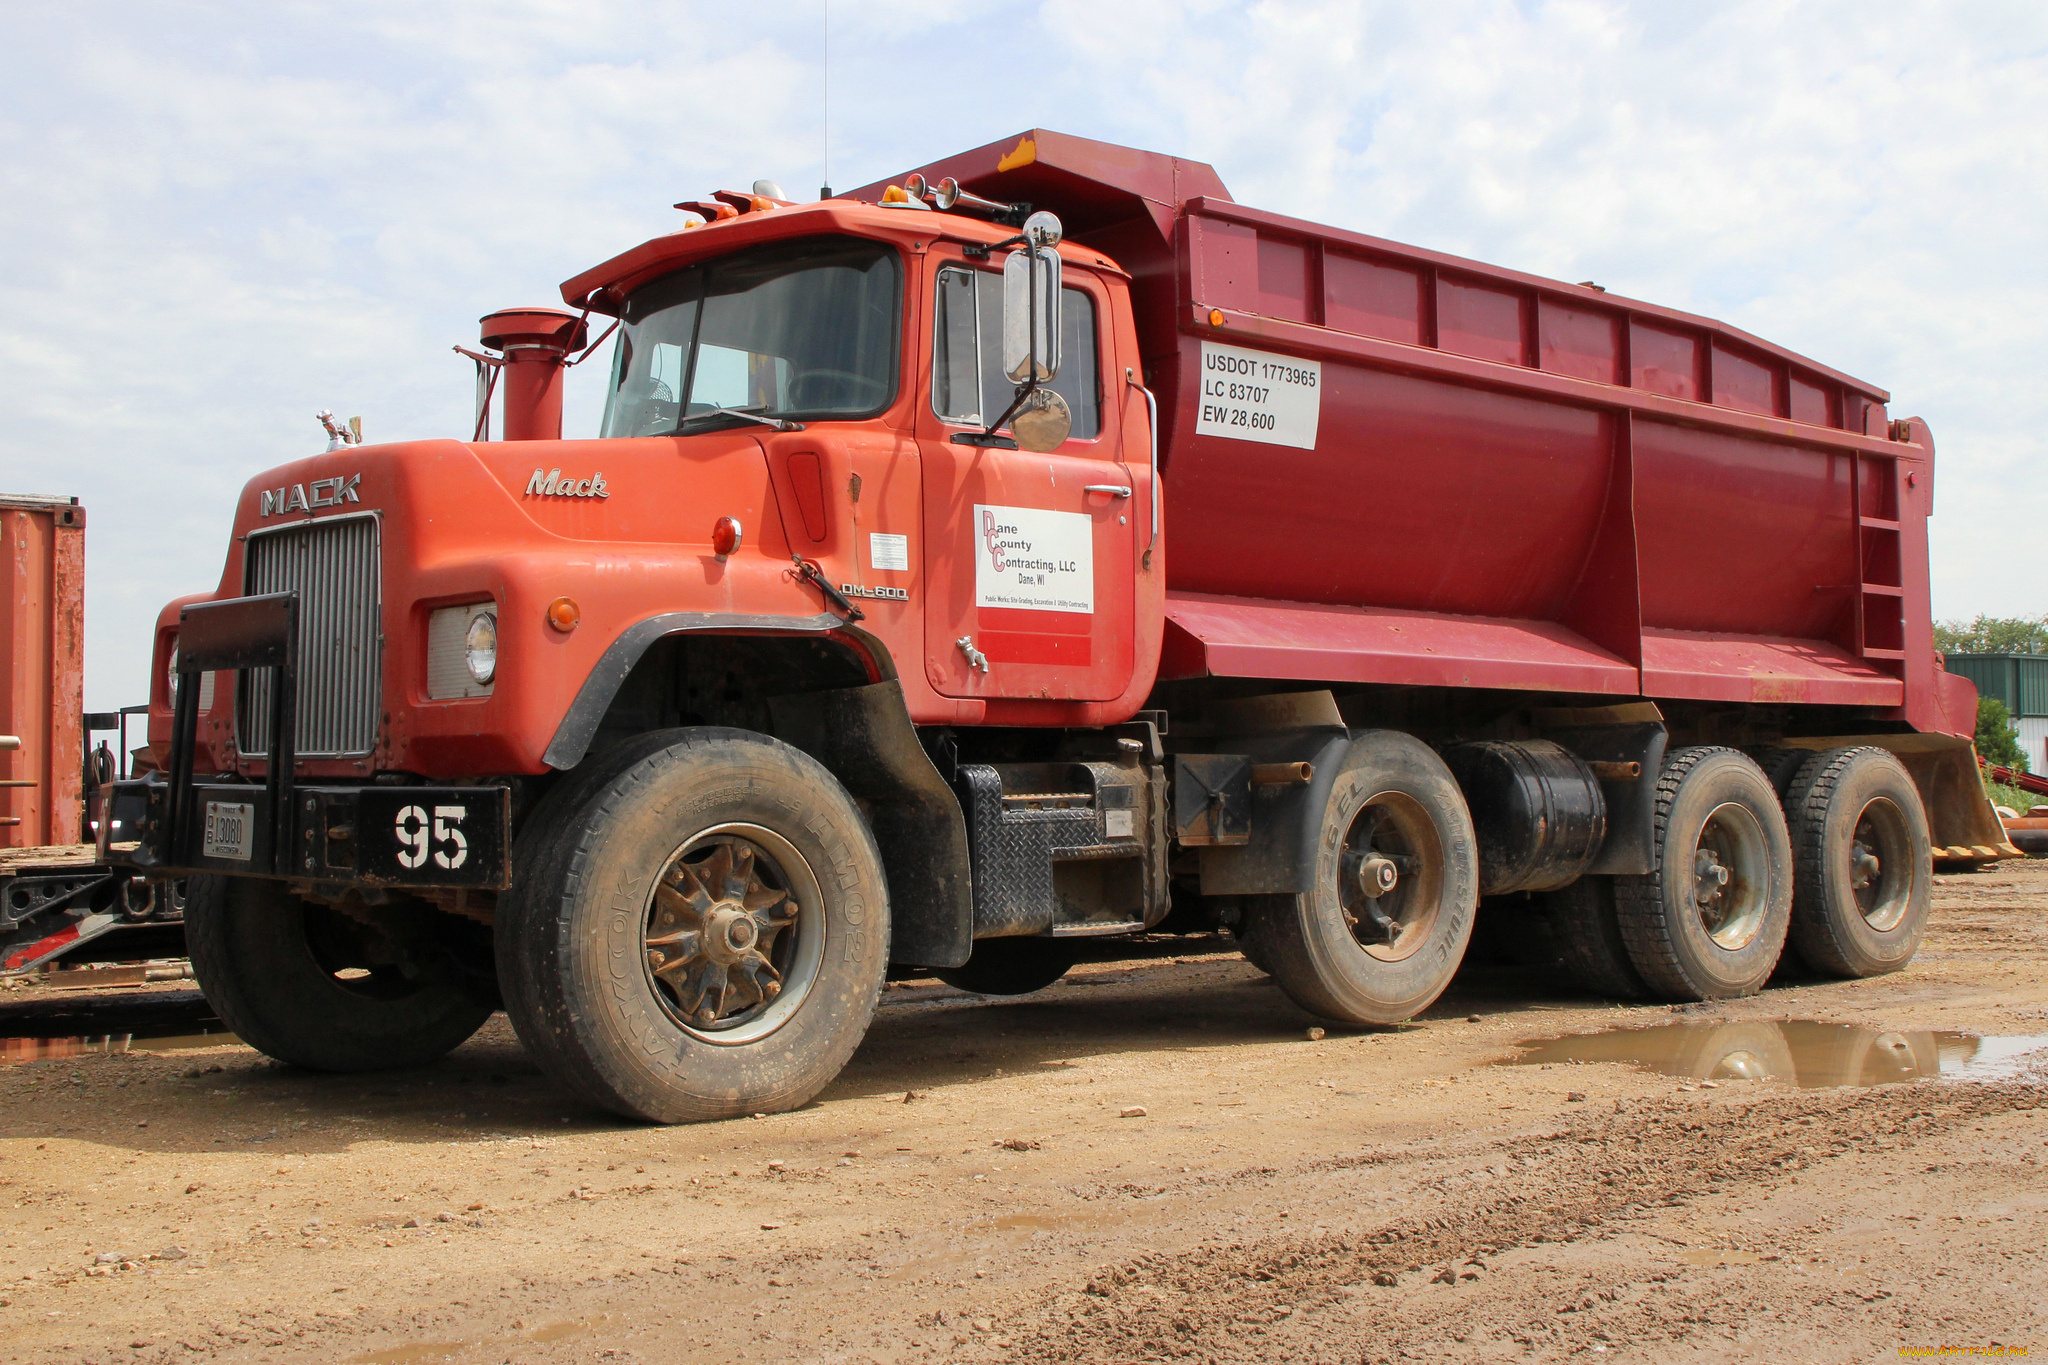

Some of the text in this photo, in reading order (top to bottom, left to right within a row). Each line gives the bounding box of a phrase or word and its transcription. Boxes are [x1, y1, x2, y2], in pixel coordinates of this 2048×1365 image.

[1206, 353, 1316, 388] USDOT 1773965
[1205, 379, 1270, 404] LC 83707
[1203, 405, 1275, 431] EW 28,600
[260, 472, 361, 518] MACK
[526, 468, 611, 498] Mack
[983, 510, 1018, 537] Dane
[986, 528, 1032, 554] County
[992, 547, 1076, 573] Contracting, LLC
[841, 583, 907, 599] DM-600
[1018, 573, 1045, 588] Dane, WI
[985, 595, 997, 603] Public
[1034, 598, 1053, 606] Excavation
[1057, 599, 1068, 608] Utility
[1068, 601, 1089, 610] Contracting
[215, 816, 242, 844] 13080
[395, 805, 468, 869] 95
